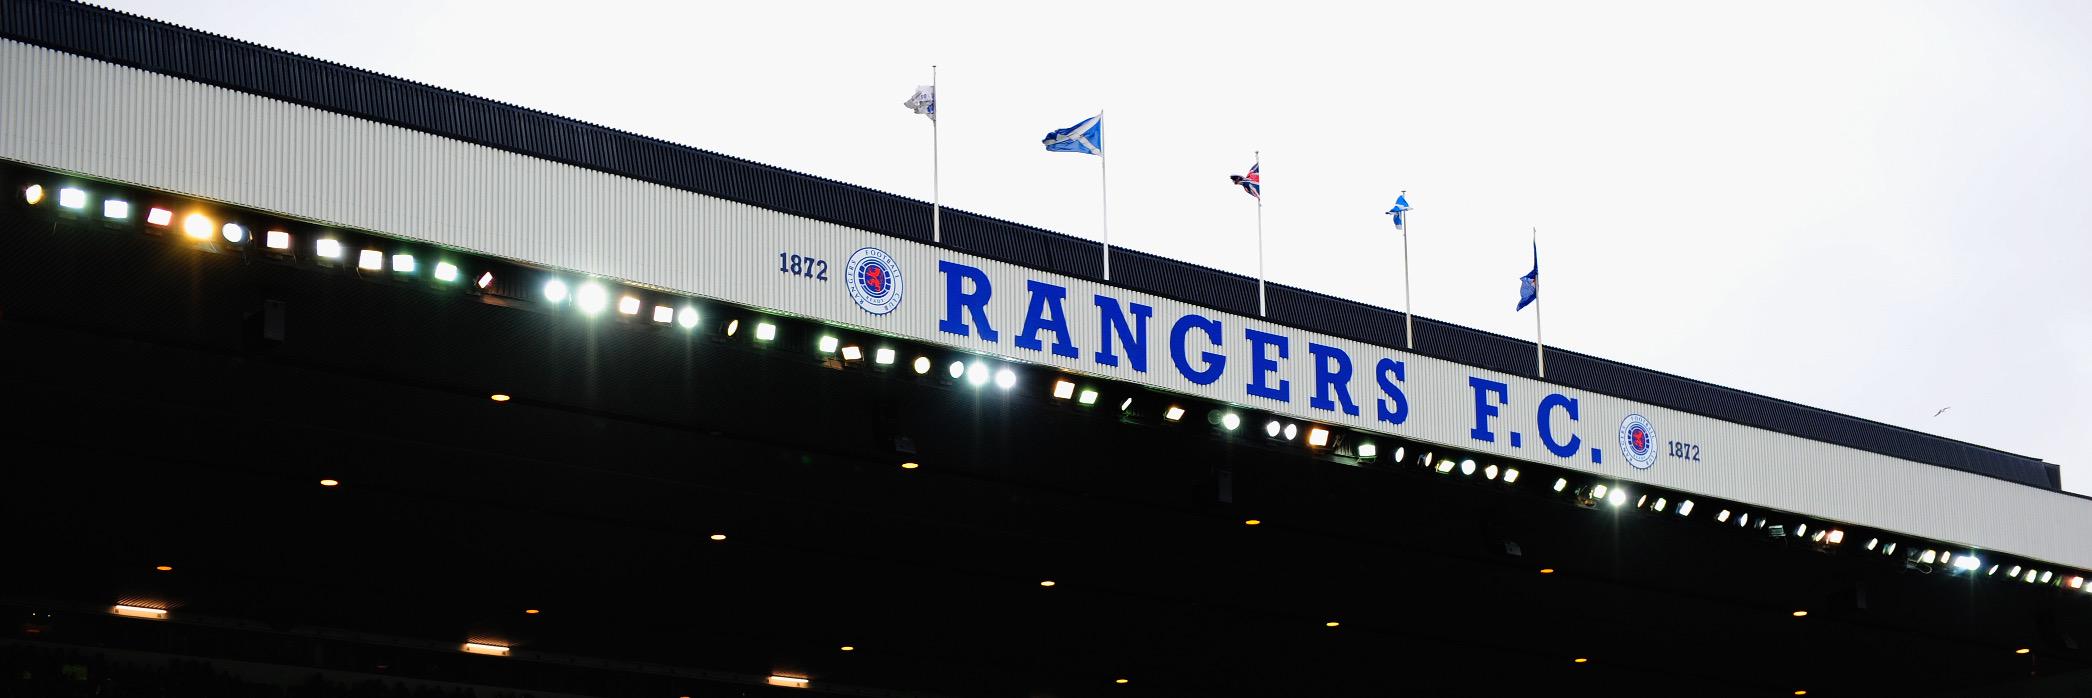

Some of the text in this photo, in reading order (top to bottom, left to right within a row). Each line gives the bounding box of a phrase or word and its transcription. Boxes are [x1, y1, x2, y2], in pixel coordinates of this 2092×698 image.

[780, 252, 828, 282] 1872
[865, 249, 900, 278] FOOTBALL
[939, 260, 1603, 465] RANGERS F.C.
[1668, 440, 1701, 462] 1872
